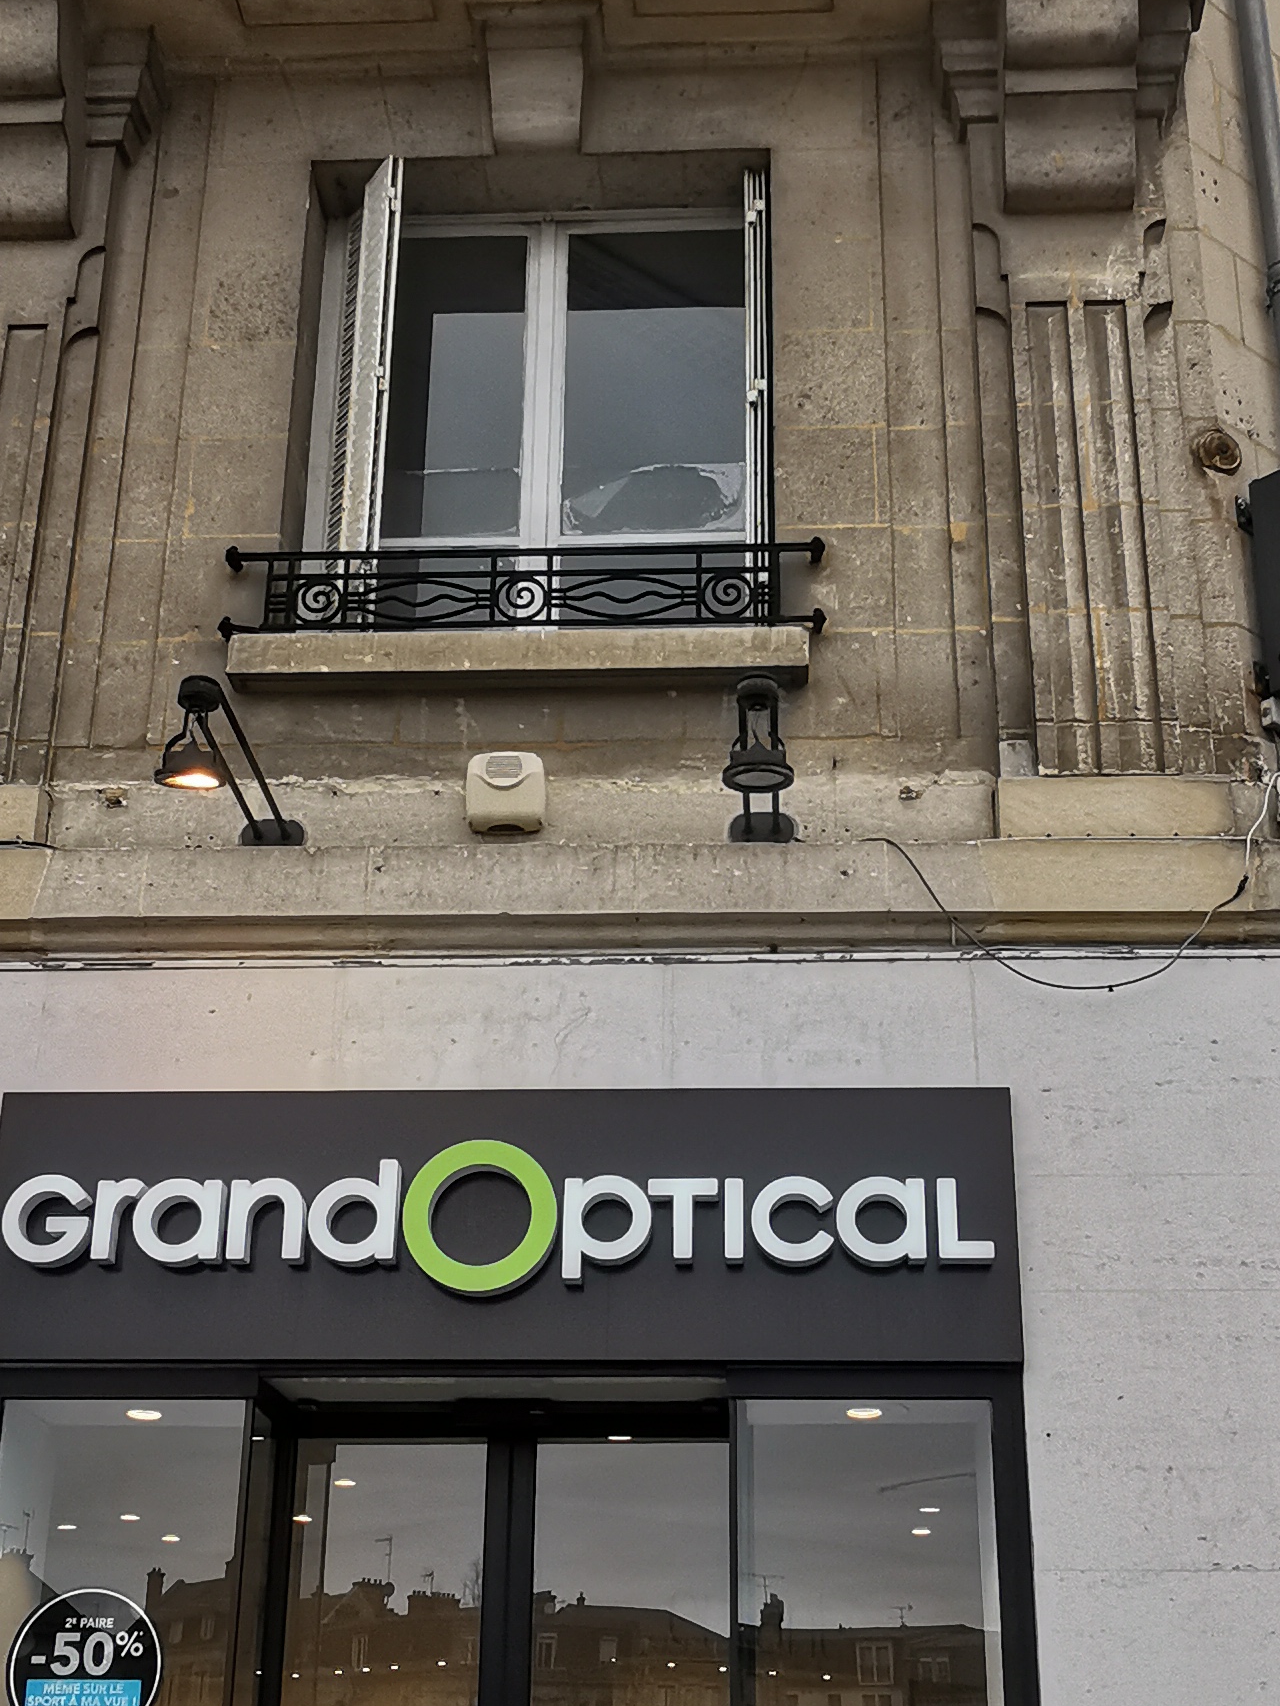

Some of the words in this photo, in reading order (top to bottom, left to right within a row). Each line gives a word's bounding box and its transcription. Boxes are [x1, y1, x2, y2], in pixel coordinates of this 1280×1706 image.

[1, 1139, 996, 1294] GrandOptical
[79, 1617, 115, 1629] PAIRE
[82, 1683, 108, 1694] SUR
[109, 1683, 125, 1694] LE
[26, 1695, 67, 1706] SPORT
[80, 1695, 101, 1706] MA
[104, 1695, 127, 1706] VUE
